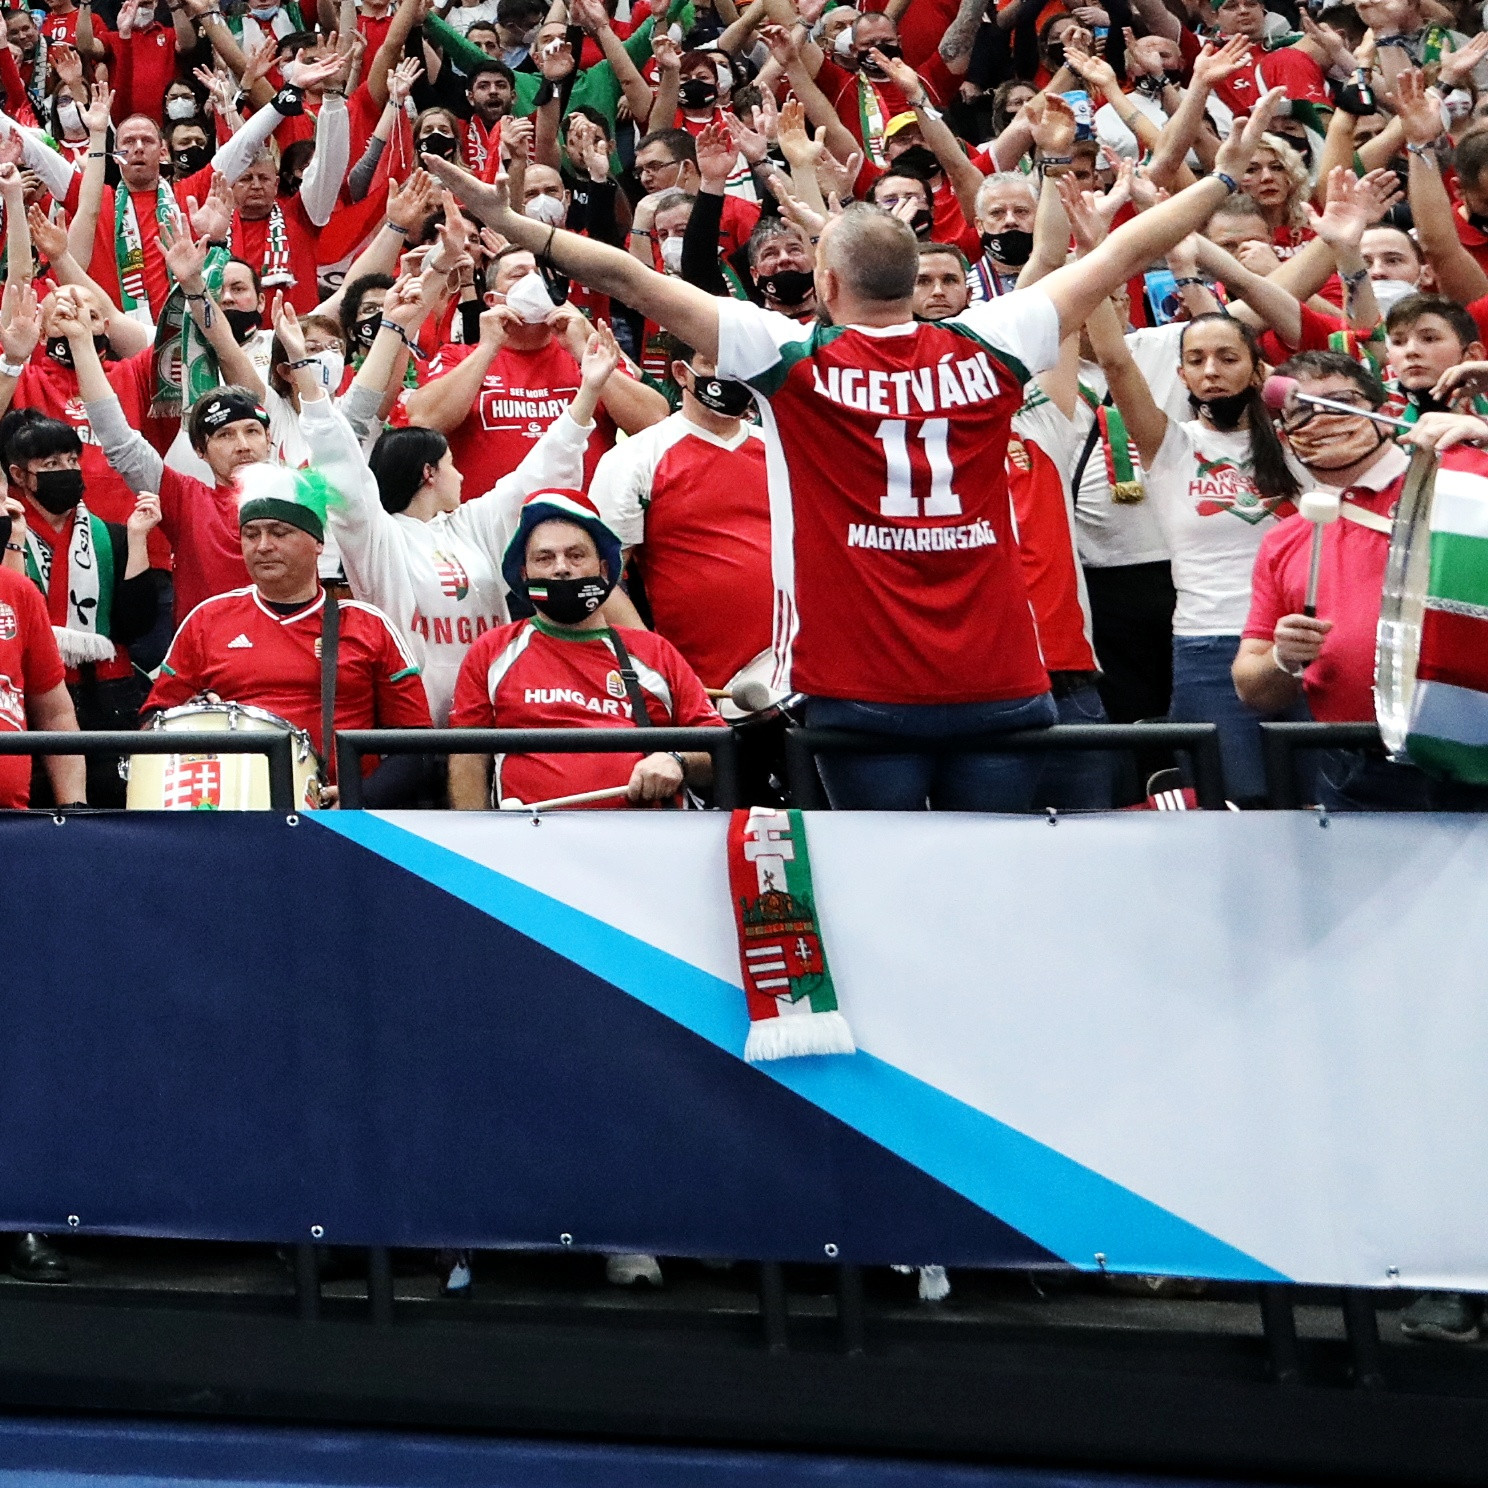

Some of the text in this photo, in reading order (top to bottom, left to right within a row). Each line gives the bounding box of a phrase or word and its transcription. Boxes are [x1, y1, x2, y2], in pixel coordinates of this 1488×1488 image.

[509, 387, 549, 398] SEE MORE
[492, 398, 571, 419] HUNGARY
[874, 417, 963, 517] 11
[847, 519, 997, 552] MAGYARORSZÁG
[524, 688, 634, 718] HUNGARY
